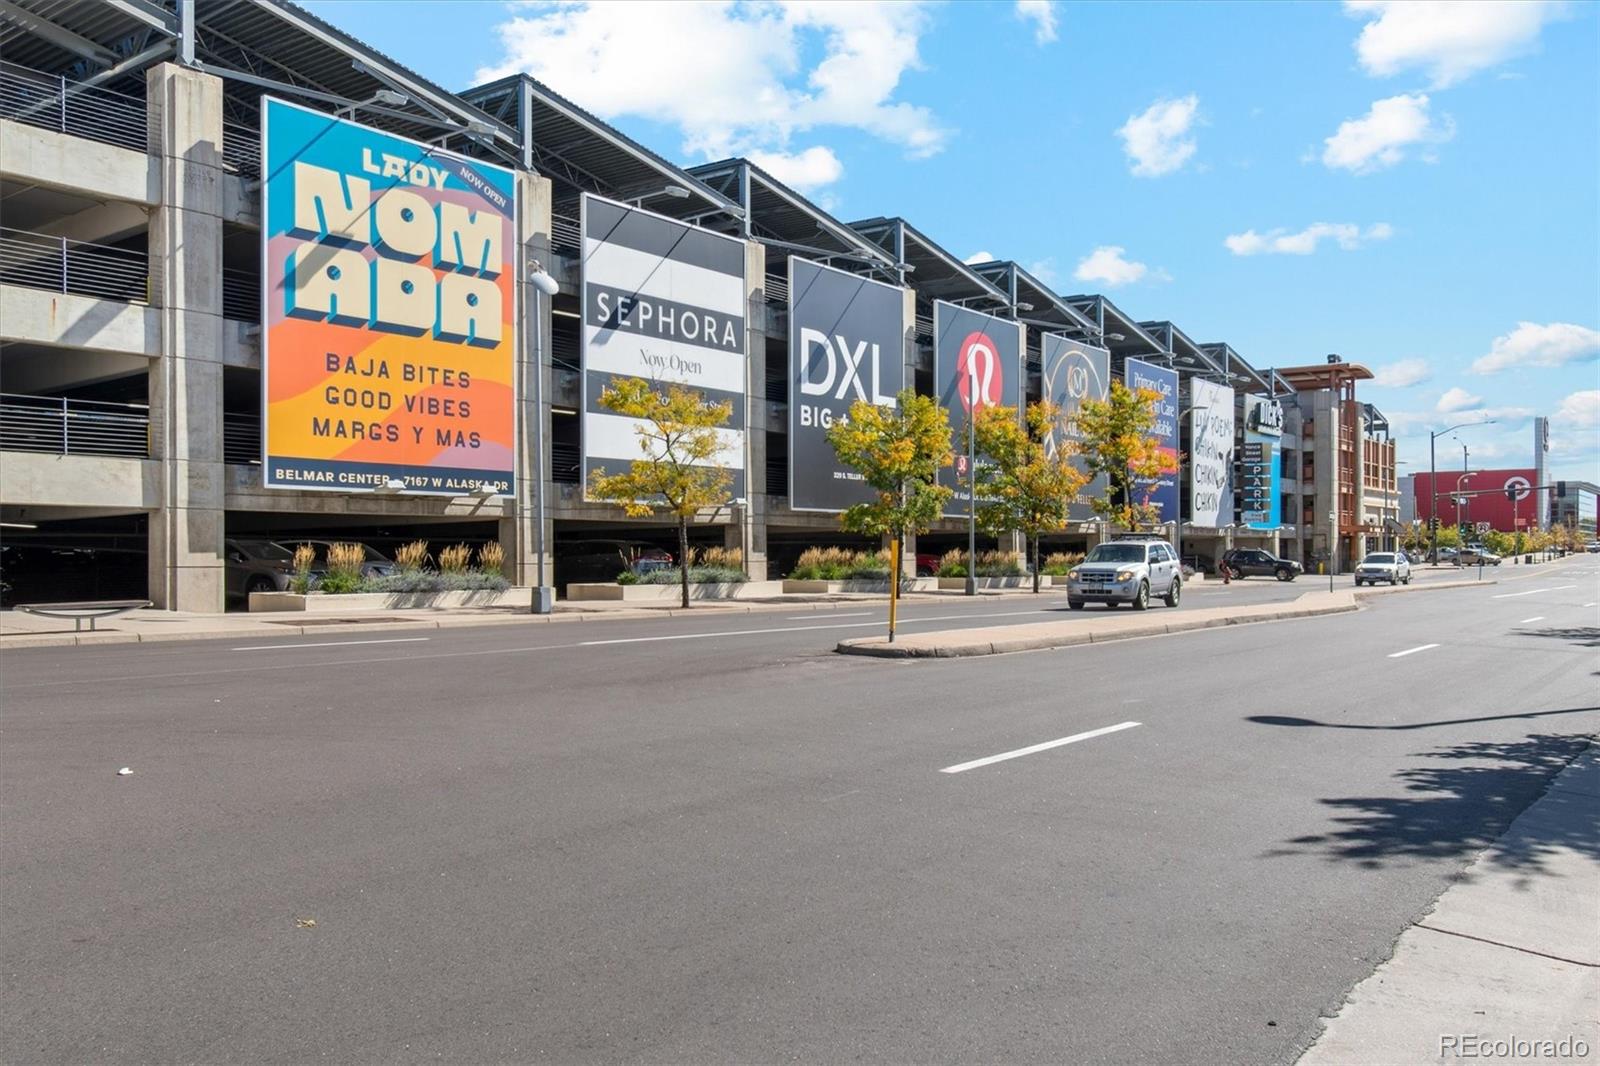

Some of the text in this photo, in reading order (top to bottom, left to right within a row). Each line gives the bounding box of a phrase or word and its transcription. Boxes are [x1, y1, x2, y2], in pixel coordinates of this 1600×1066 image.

[363, 147, 450, 192] LADY
[459, 166, 507, 209] NOW OPEN
[290, 160, 502, 278] NOM
[289, 241, 502, 346] ADA
[597, 292, 737, 348] SEPHORA
[325, 352, 471, 389] BAJA BITES
[640, 348, 703, 375] Now Open
[800, 327, 897, 409] DXL
[325, 386, 471, 418] GOOD VIBES
[1158, 378, 1173, 397] Care
[800, 405, 833, 429] BIG
[1160, 400, 1175, 417] Care
[312, 417, 481, 449] MARGS Y MAS
[275, 468, 509, 491] BELMAR CENTER 7167 W ALASKA DR
[1253, 466, 1262, 510] PARK
